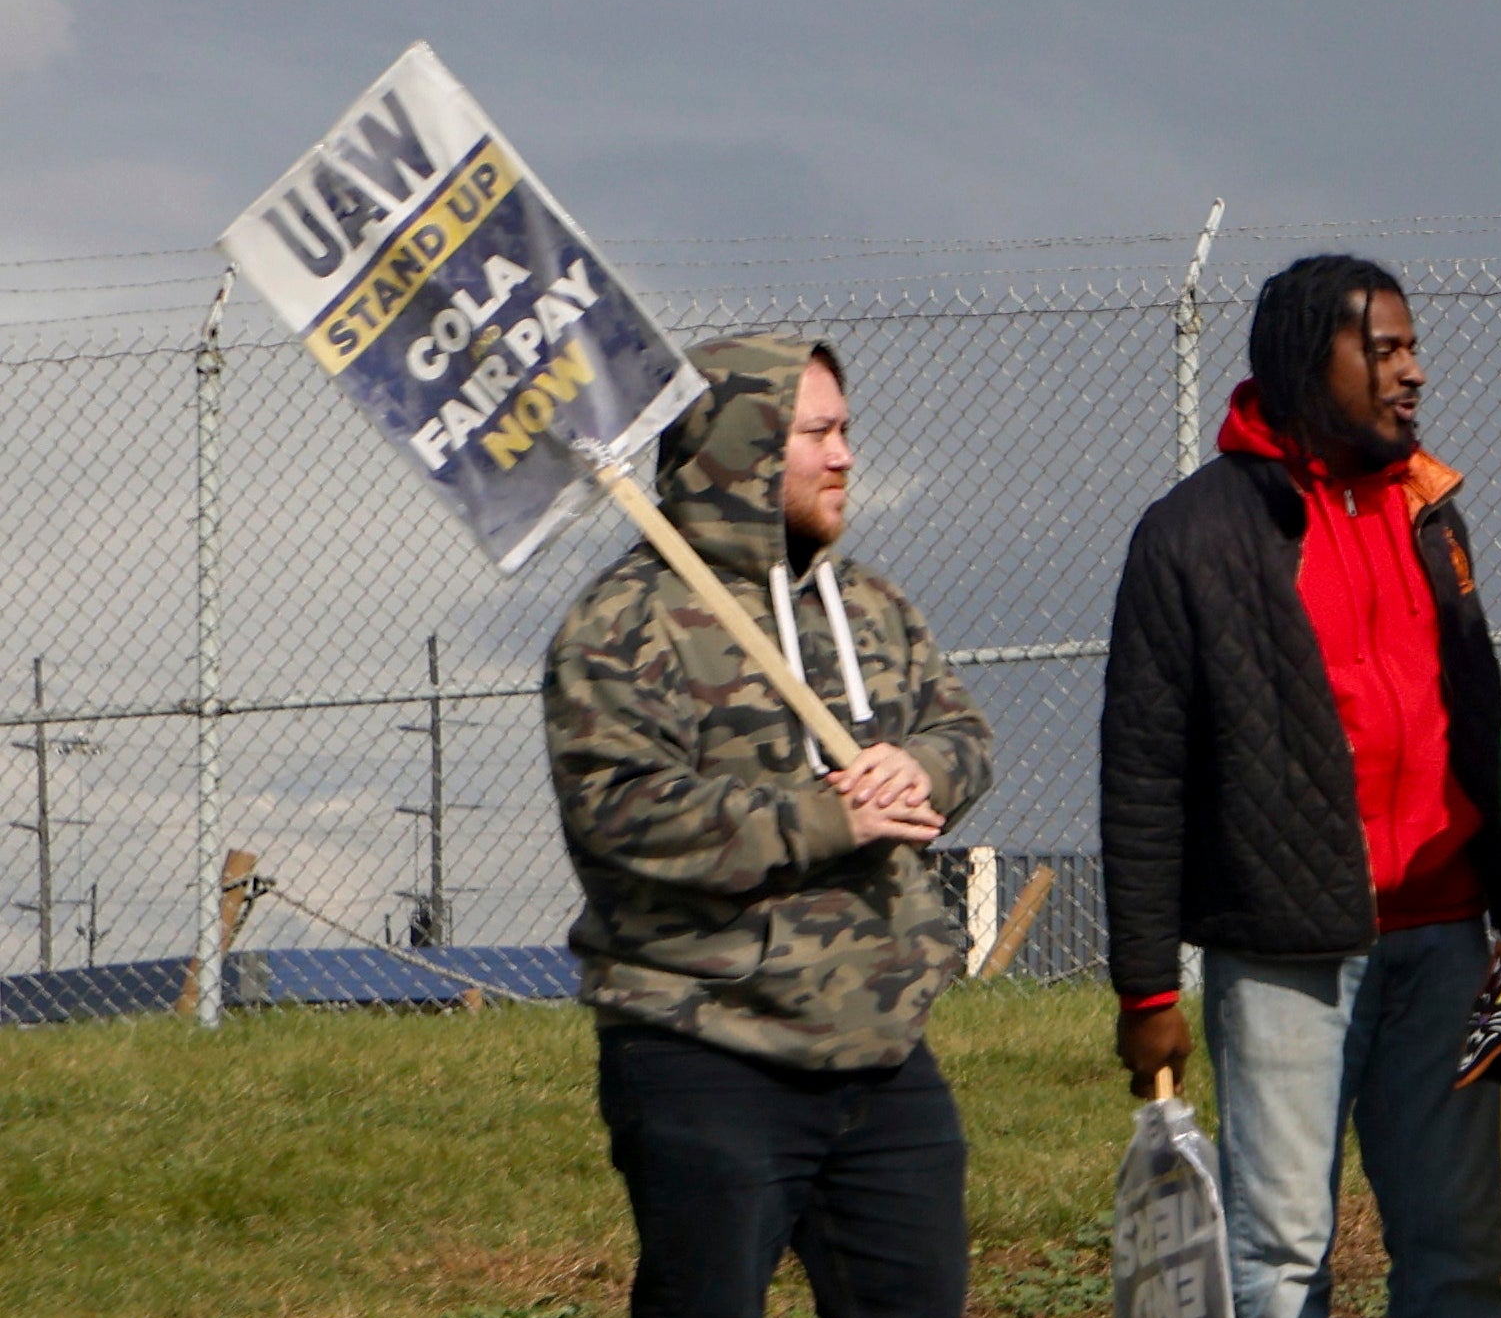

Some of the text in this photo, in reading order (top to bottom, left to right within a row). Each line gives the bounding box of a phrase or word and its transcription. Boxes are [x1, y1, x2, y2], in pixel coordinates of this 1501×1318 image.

[262, 89, 438, 278] UAW
[327, 161, 500, 356] STAND UP
[406, 254, 533, 382] COLA
[409, 258, 598, 472] FAIR PAY
[482, 339, 596, 471] NOW
